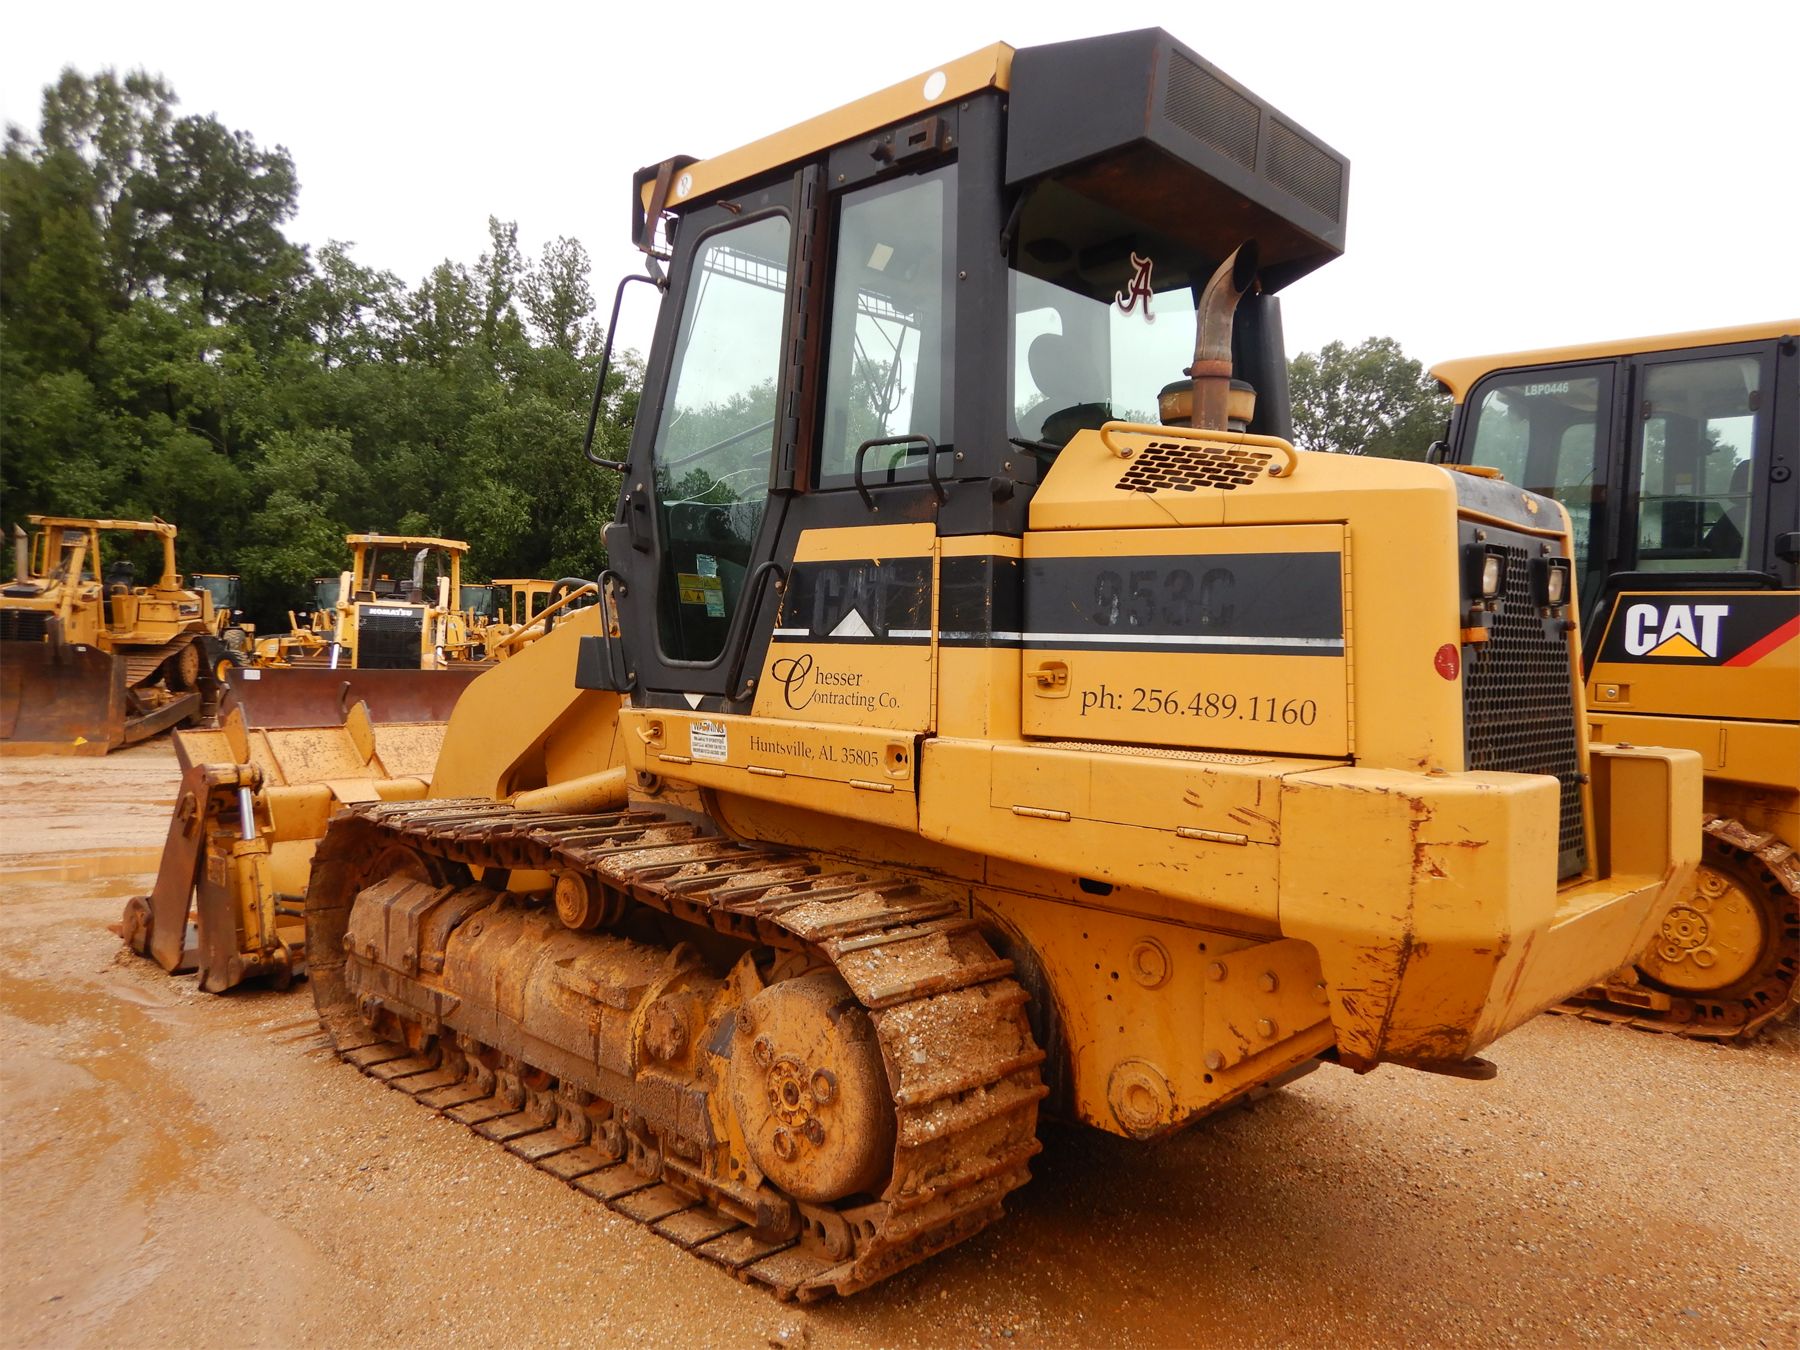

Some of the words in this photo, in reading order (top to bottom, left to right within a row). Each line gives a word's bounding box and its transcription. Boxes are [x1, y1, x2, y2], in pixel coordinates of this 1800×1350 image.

[1092, 567, 1236, 627] 953C
[1624, 603, 1729, 658] CAT
[879, 692, 900, 709] Co.
[1080, 684, 1123, 716] ph:
[1131, 687, 1317, 726] 256.489.1160
[750, 735, 815, 761] Huntsville,
[819, 745, 838, 762] AL
[841, 747, 879, 767] 35805
